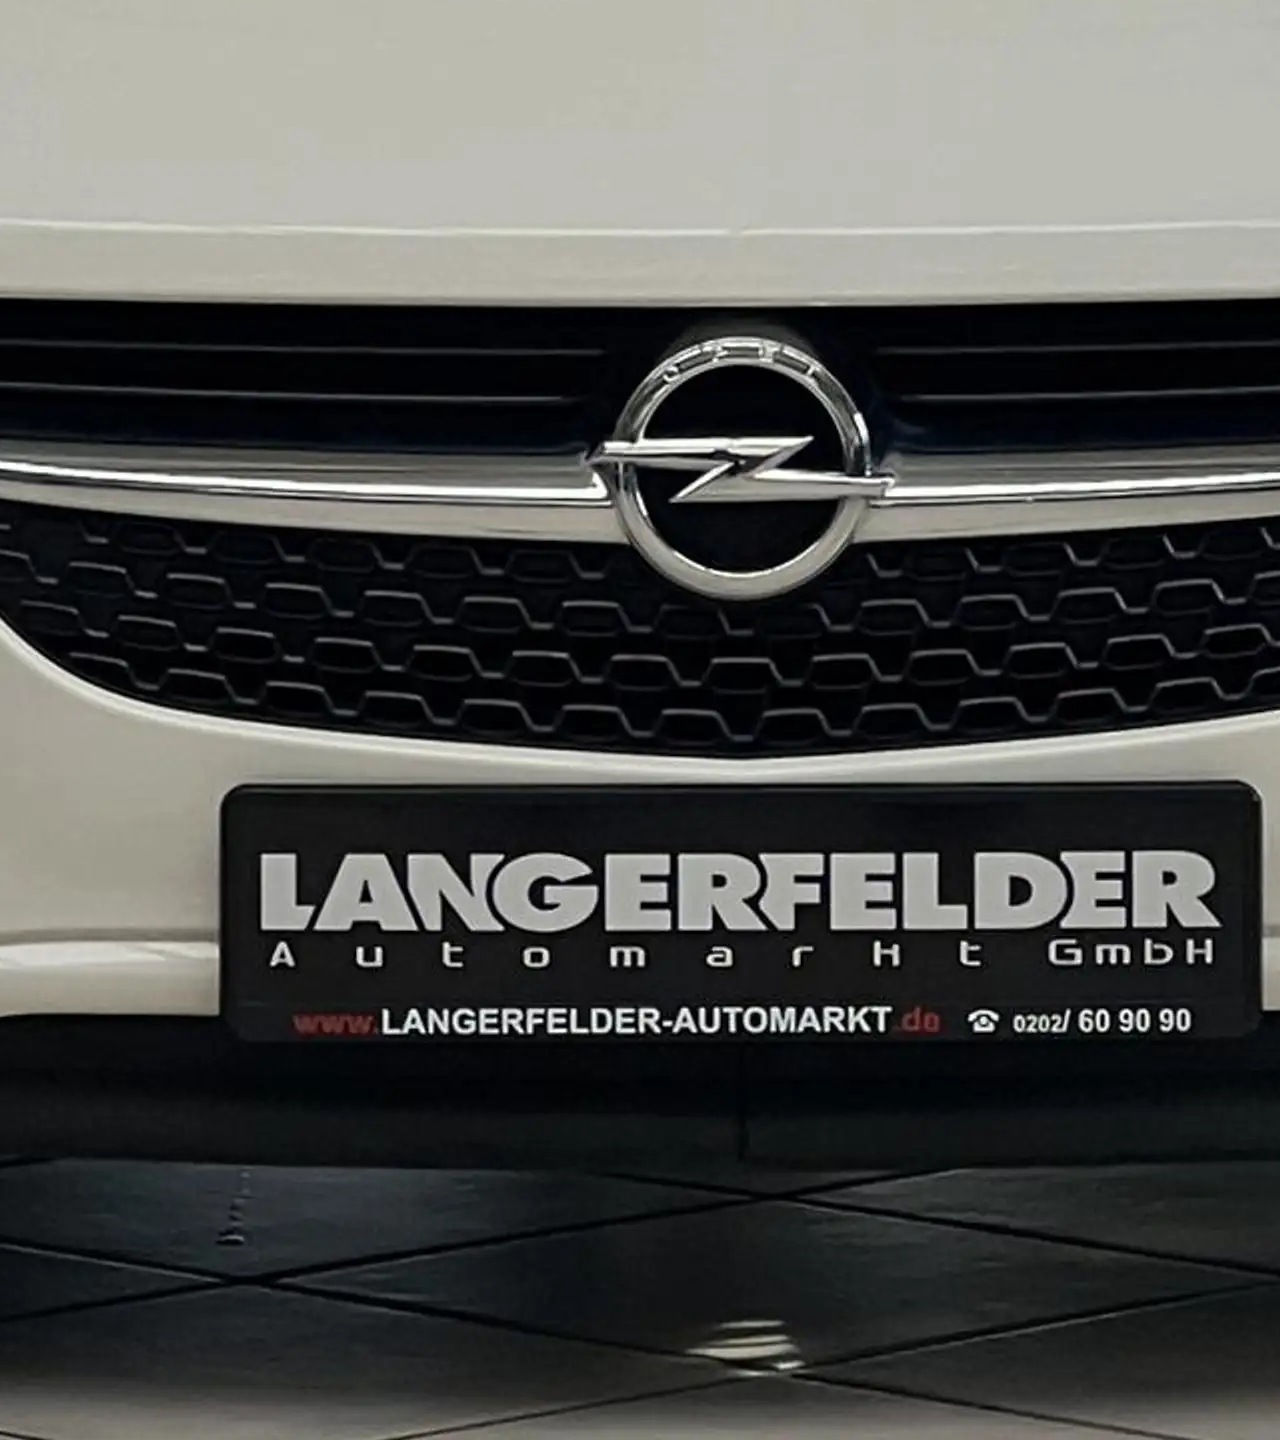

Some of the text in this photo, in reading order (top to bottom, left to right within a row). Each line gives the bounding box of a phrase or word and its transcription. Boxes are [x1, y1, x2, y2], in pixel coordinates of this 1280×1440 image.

[260, 850, 1222, 933] LANGERFELDER
[1048, 938, 1214, 966] GmbH
[1077, 1008, 1111, 1033] 60
[1118, 1008, 1151, 1033] 90
[1158, 1008, 1192, 1033] 90
